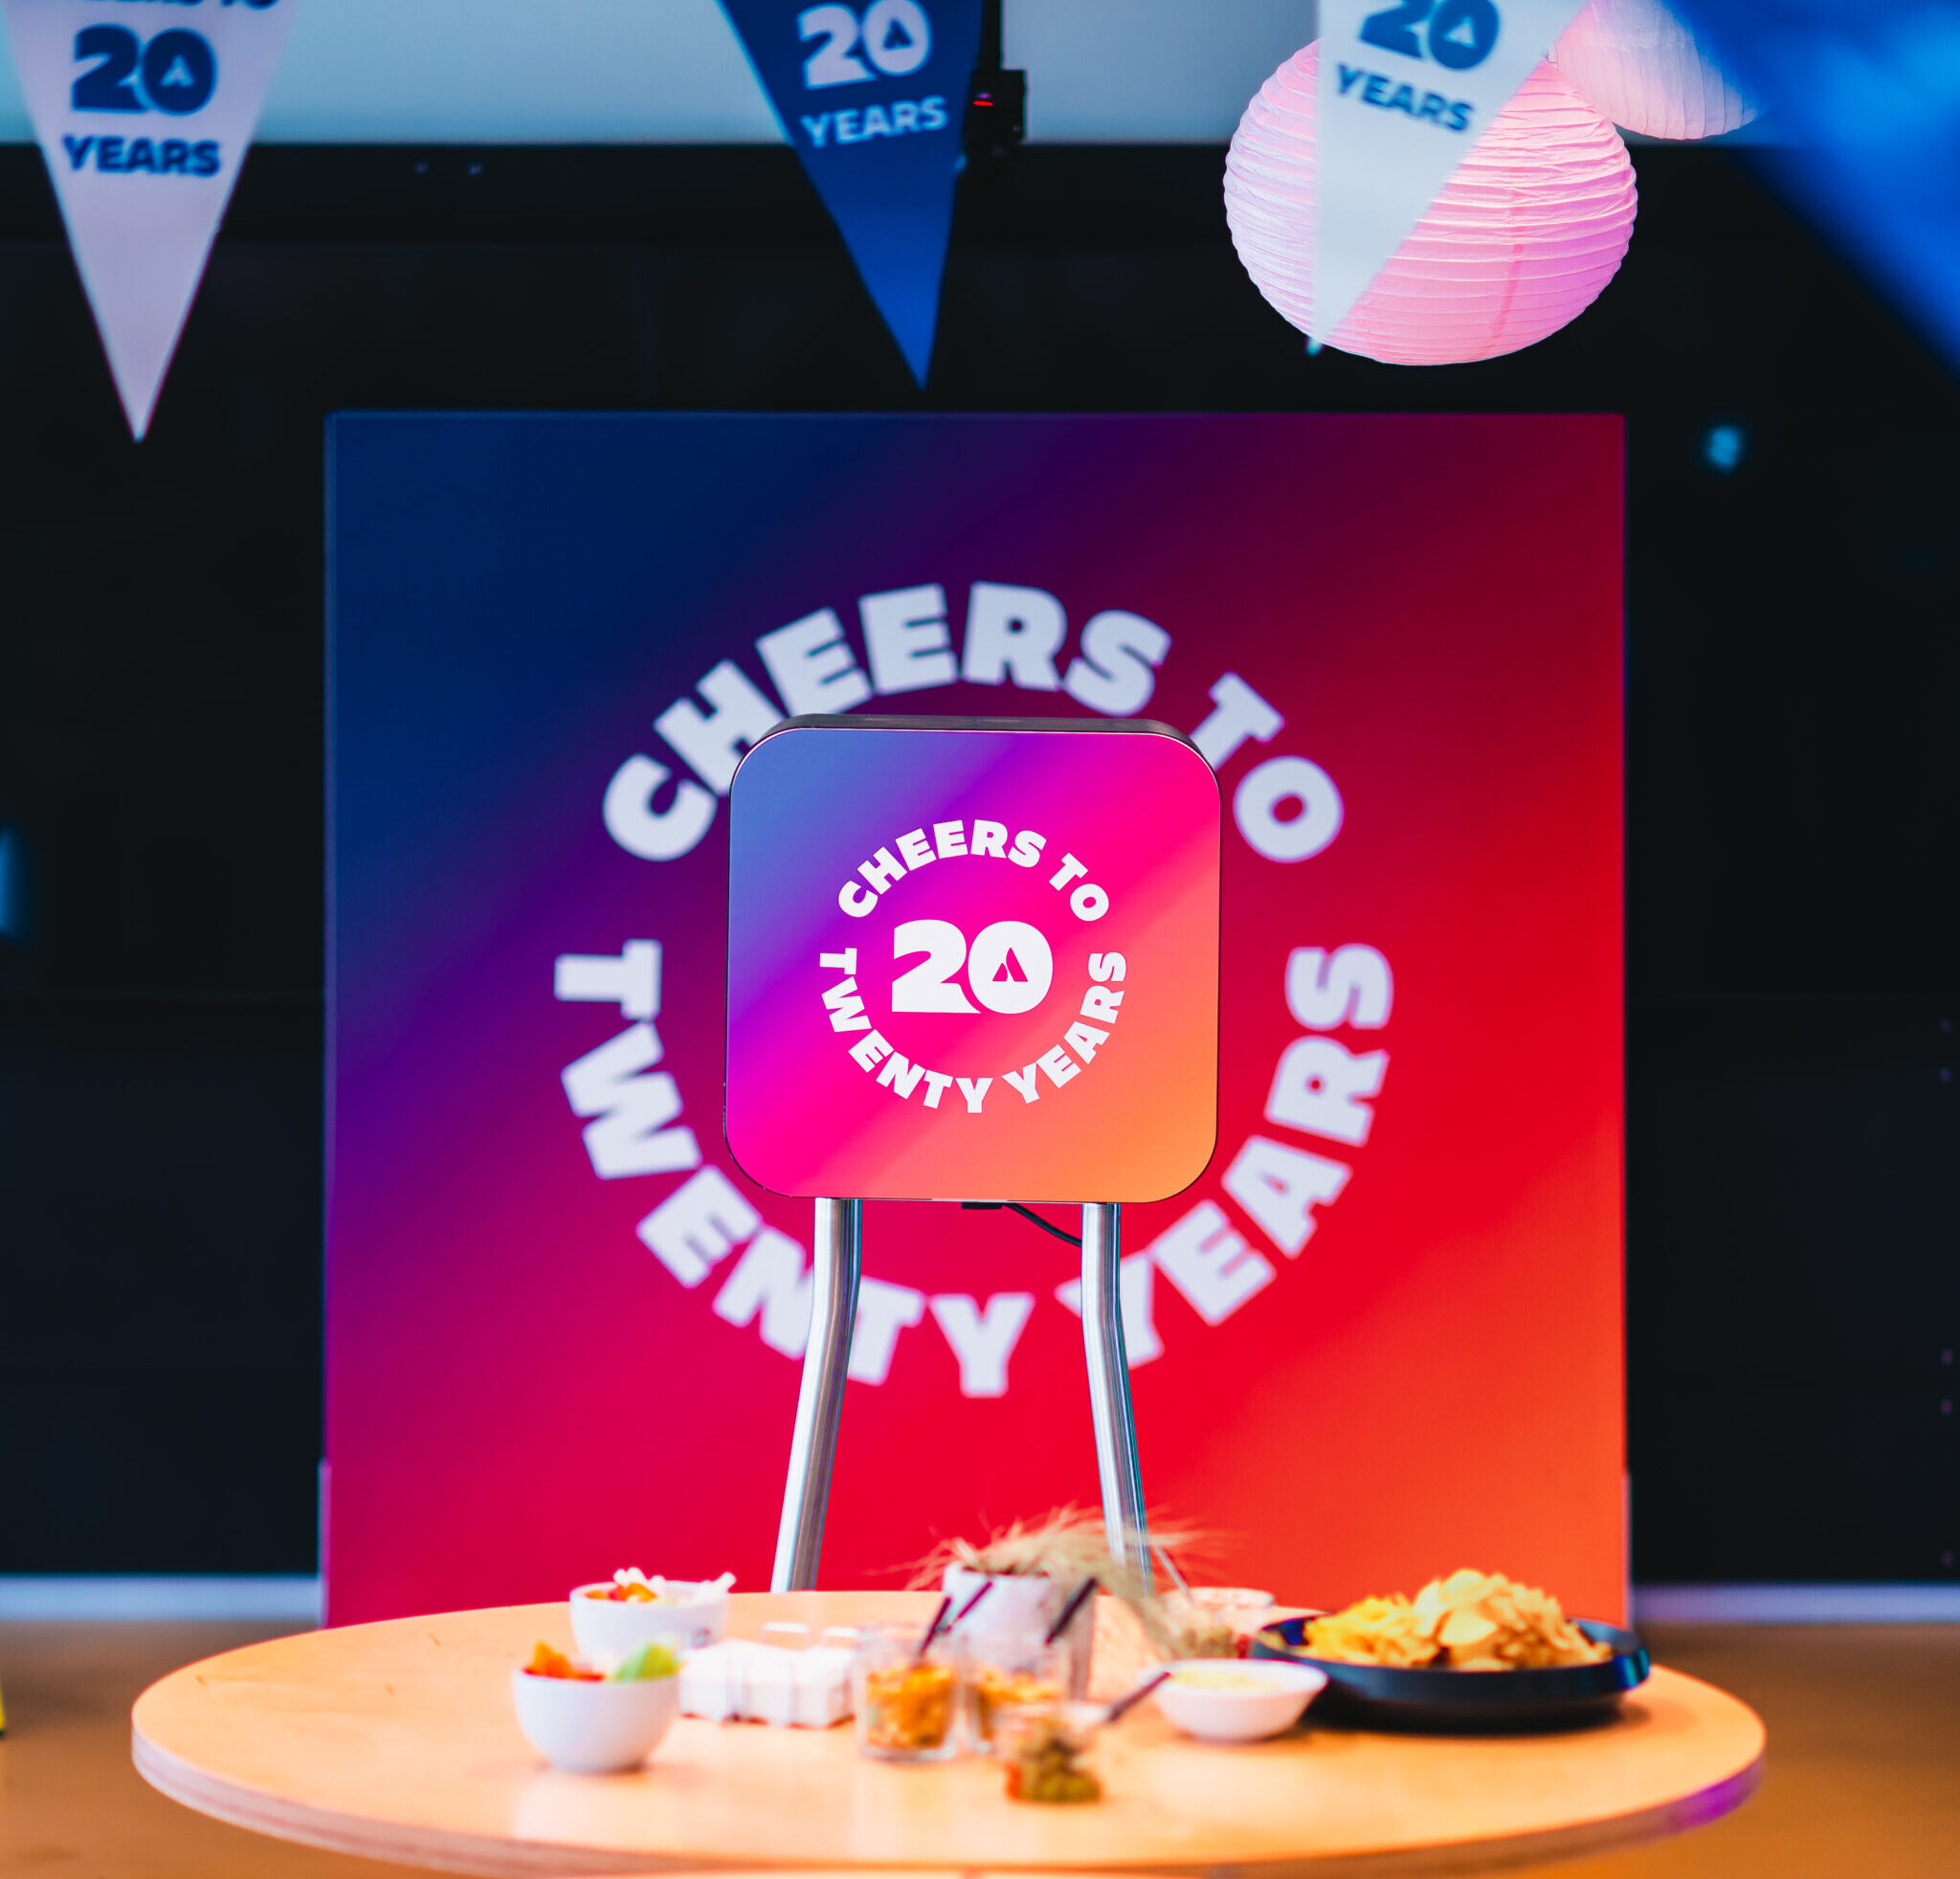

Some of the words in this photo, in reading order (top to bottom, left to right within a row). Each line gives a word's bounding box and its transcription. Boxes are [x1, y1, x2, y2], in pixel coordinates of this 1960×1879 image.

[71, 23, 218, 117] 20
[797, 0, 932, 90] 20
[800, 96, 947, 147] YEARS
[1336, 63, 1475, 132] YEARS
[62, 135, 222, 177] YEARS
[602, 581, 1172, 861] CHEERS
[1190, 671, 1345, 863] TO
[838, 819, 1047, 917] CHEERS
[1048, 852, 1109, 922] TO
[891, 919, 1053, 1015] 20
[819, 948, 993, 1113] TWENTY
[1001, 951, 1126, 1104] YEARS
[554, 938, 1035, 1397] TWENTY
